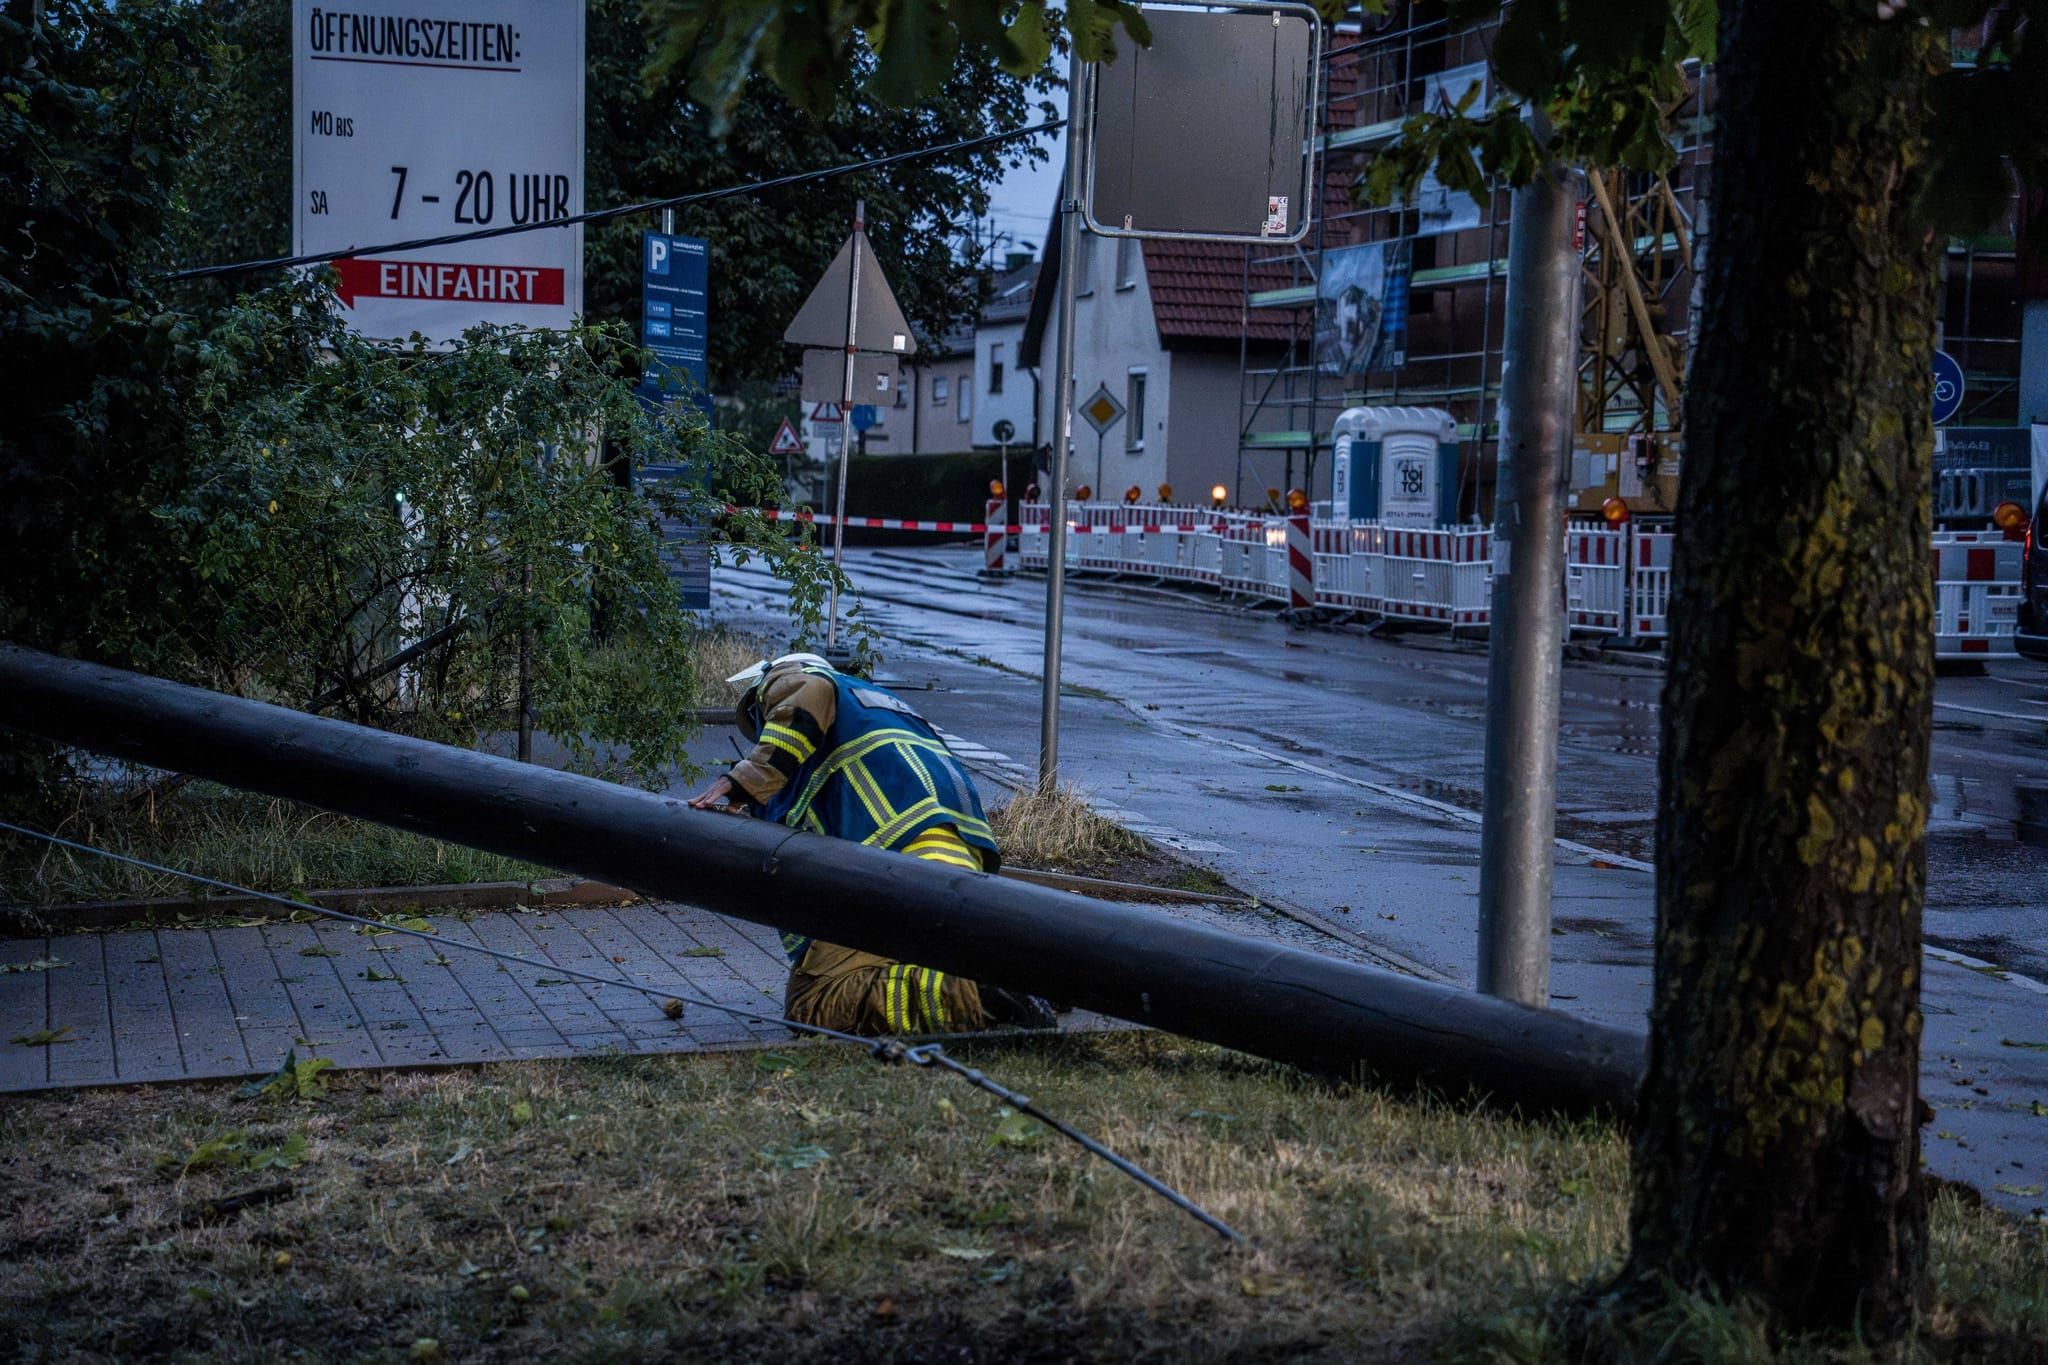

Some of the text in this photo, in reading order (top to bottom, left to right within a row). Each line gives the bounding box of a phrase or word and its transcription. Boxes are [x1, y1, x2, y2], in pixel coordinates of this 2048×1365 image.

[311, 8, 521, 63] ÖFFNUNGSZEITEN:
[311, 111, 354, 138] MO BIS
[311, 190, 328, 215] SA
[391, 166, 408, 220] 7
[454, 169, 494, 226] 20
[509, 173, 570, 228] UHR
[651, 240, 667, 270] P
[380, 263, 539, 301] EINFAHRT
[1401, 469, 1423, 481] TOI
[1401, 482, 1423, 493] TOI
